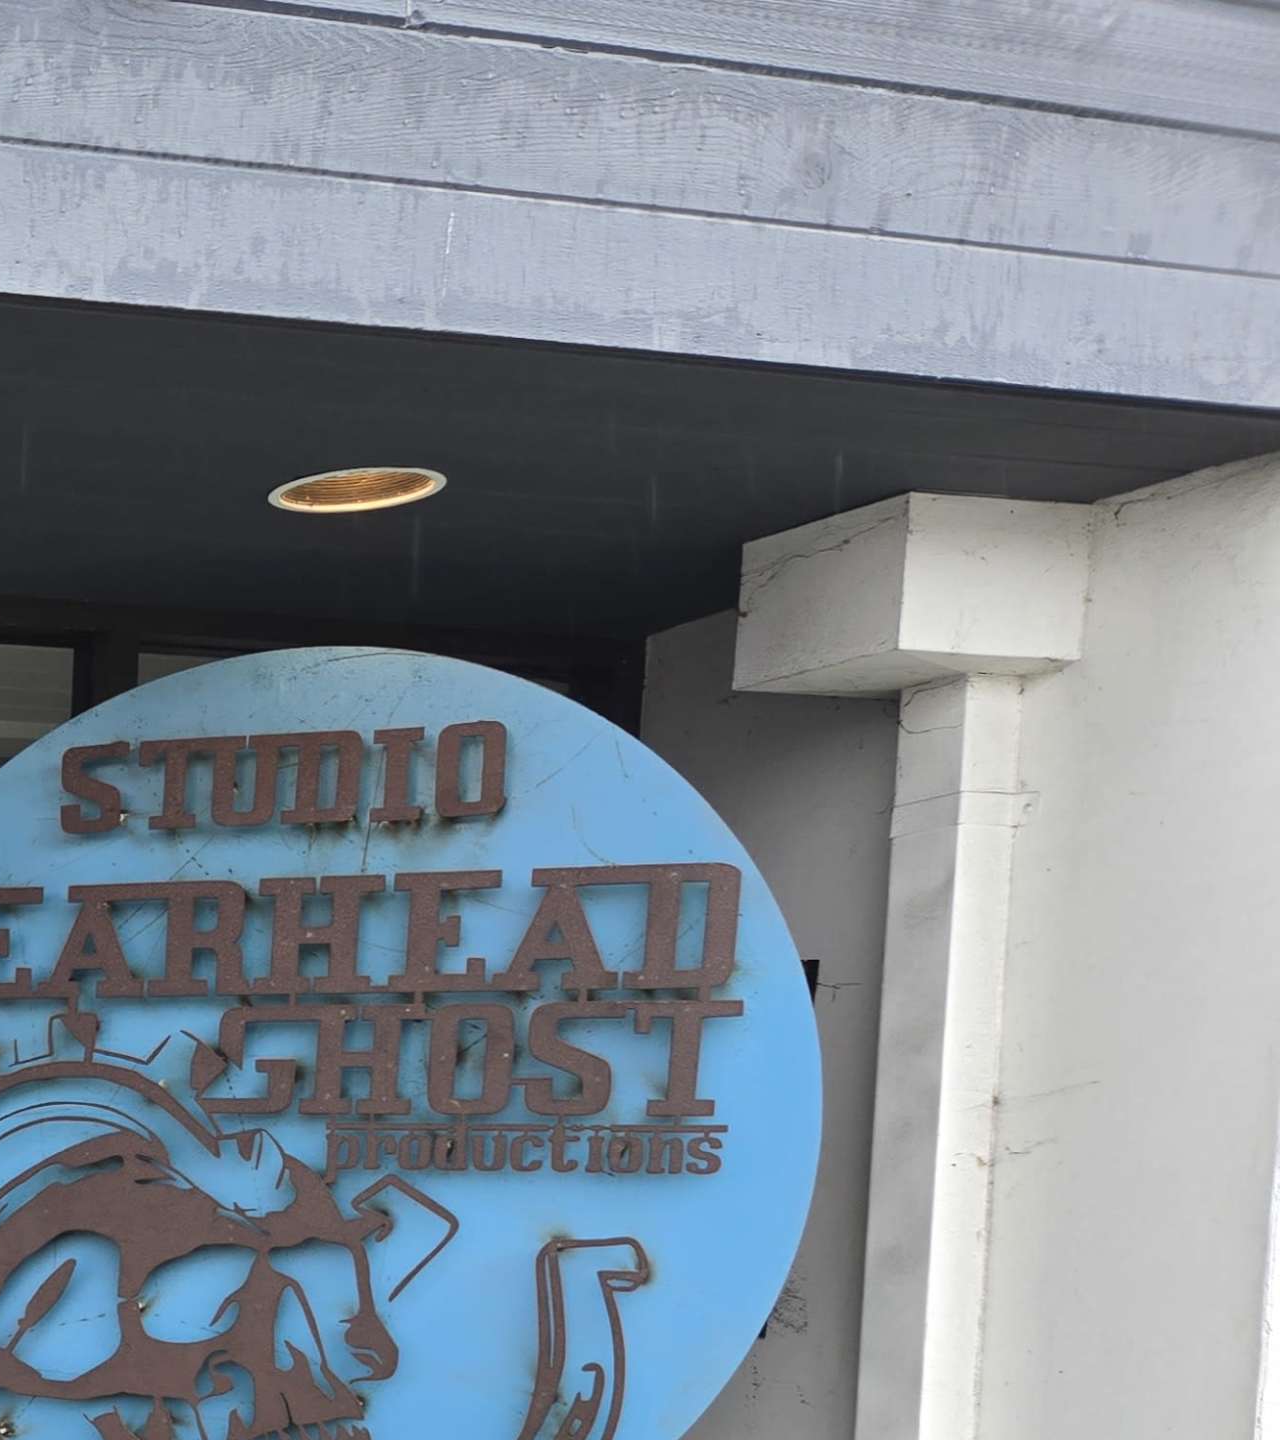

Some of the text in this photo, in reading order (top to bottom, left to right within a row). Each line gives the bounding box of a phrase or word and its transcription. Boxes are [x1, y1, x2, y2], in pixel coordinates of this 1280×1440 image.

[60, 720, 507, 835] STUDIO
[200, 999, 744, 1118] GHOST
[325, 1123, 726, 1184] productions
